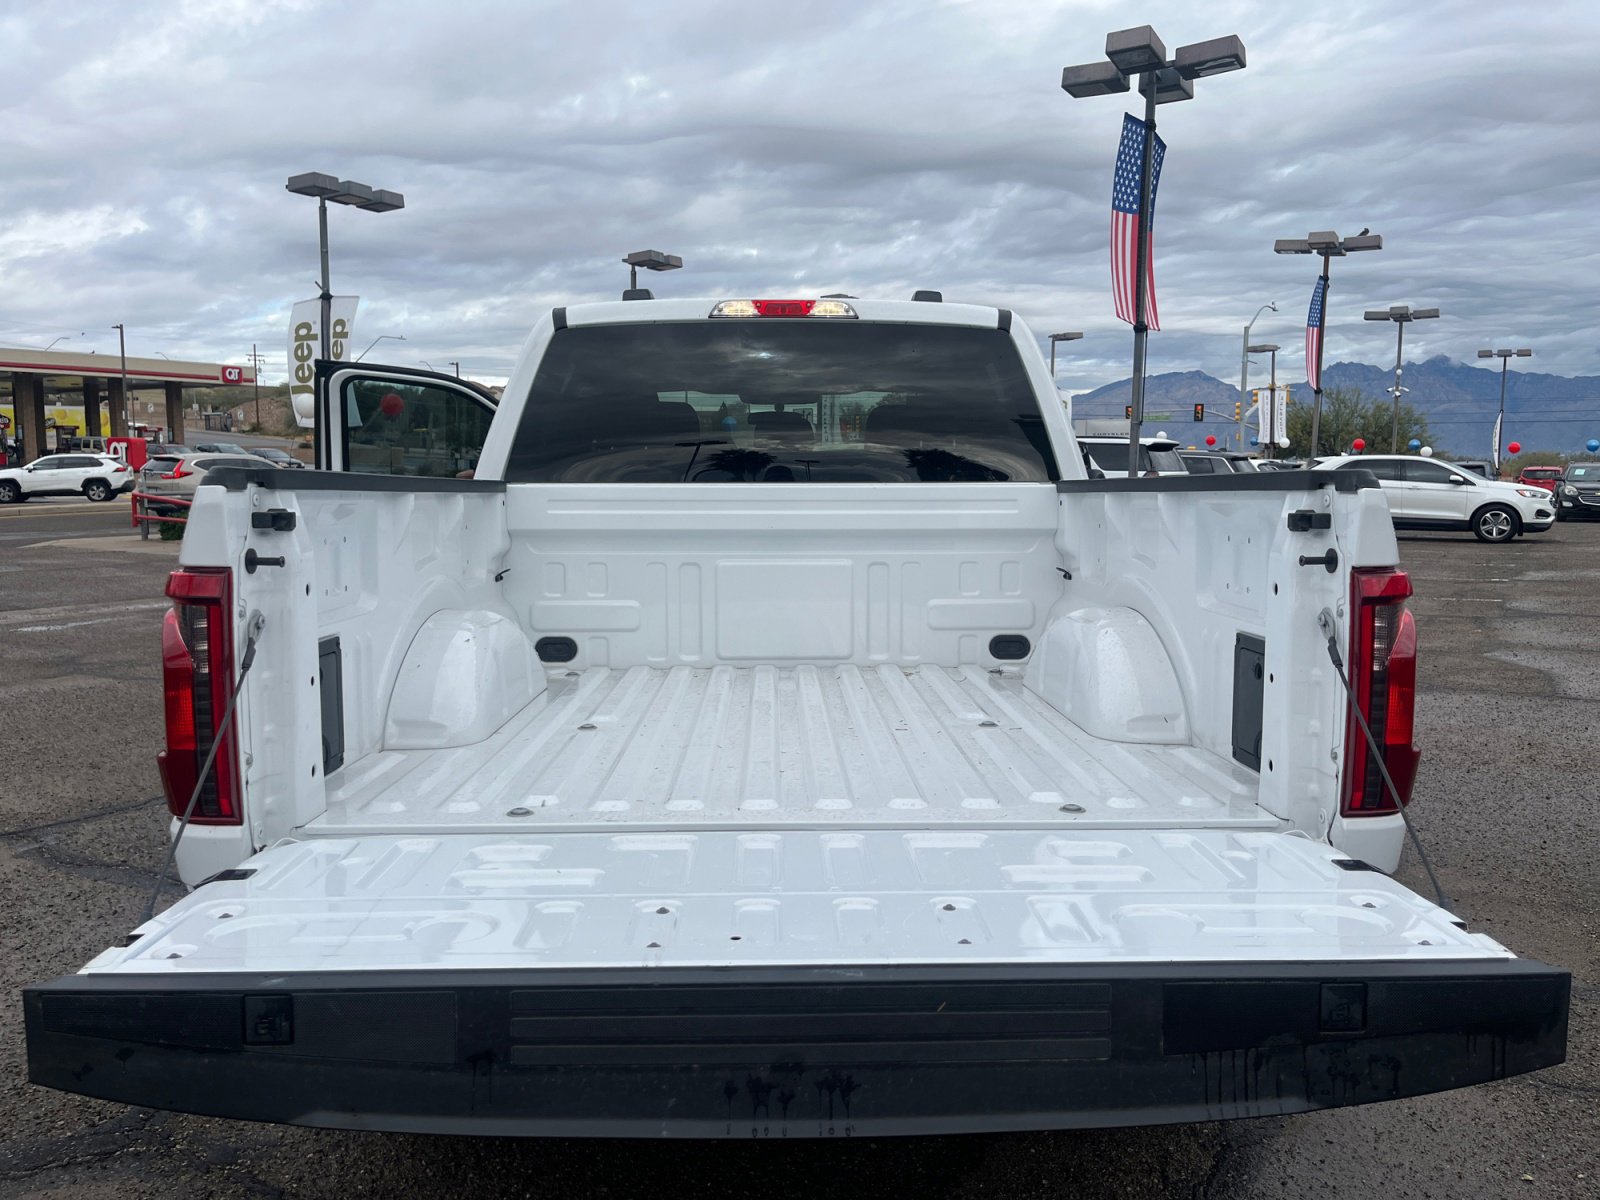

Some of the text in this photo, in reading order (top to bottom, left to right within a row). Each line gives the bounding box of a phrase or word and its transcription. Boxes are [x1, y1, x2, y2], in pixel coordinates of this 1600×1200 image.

[291, 322, 318, 394] Jeep
[332, 319, 348, 360] ep
[226, 368, 240, 380] QT
